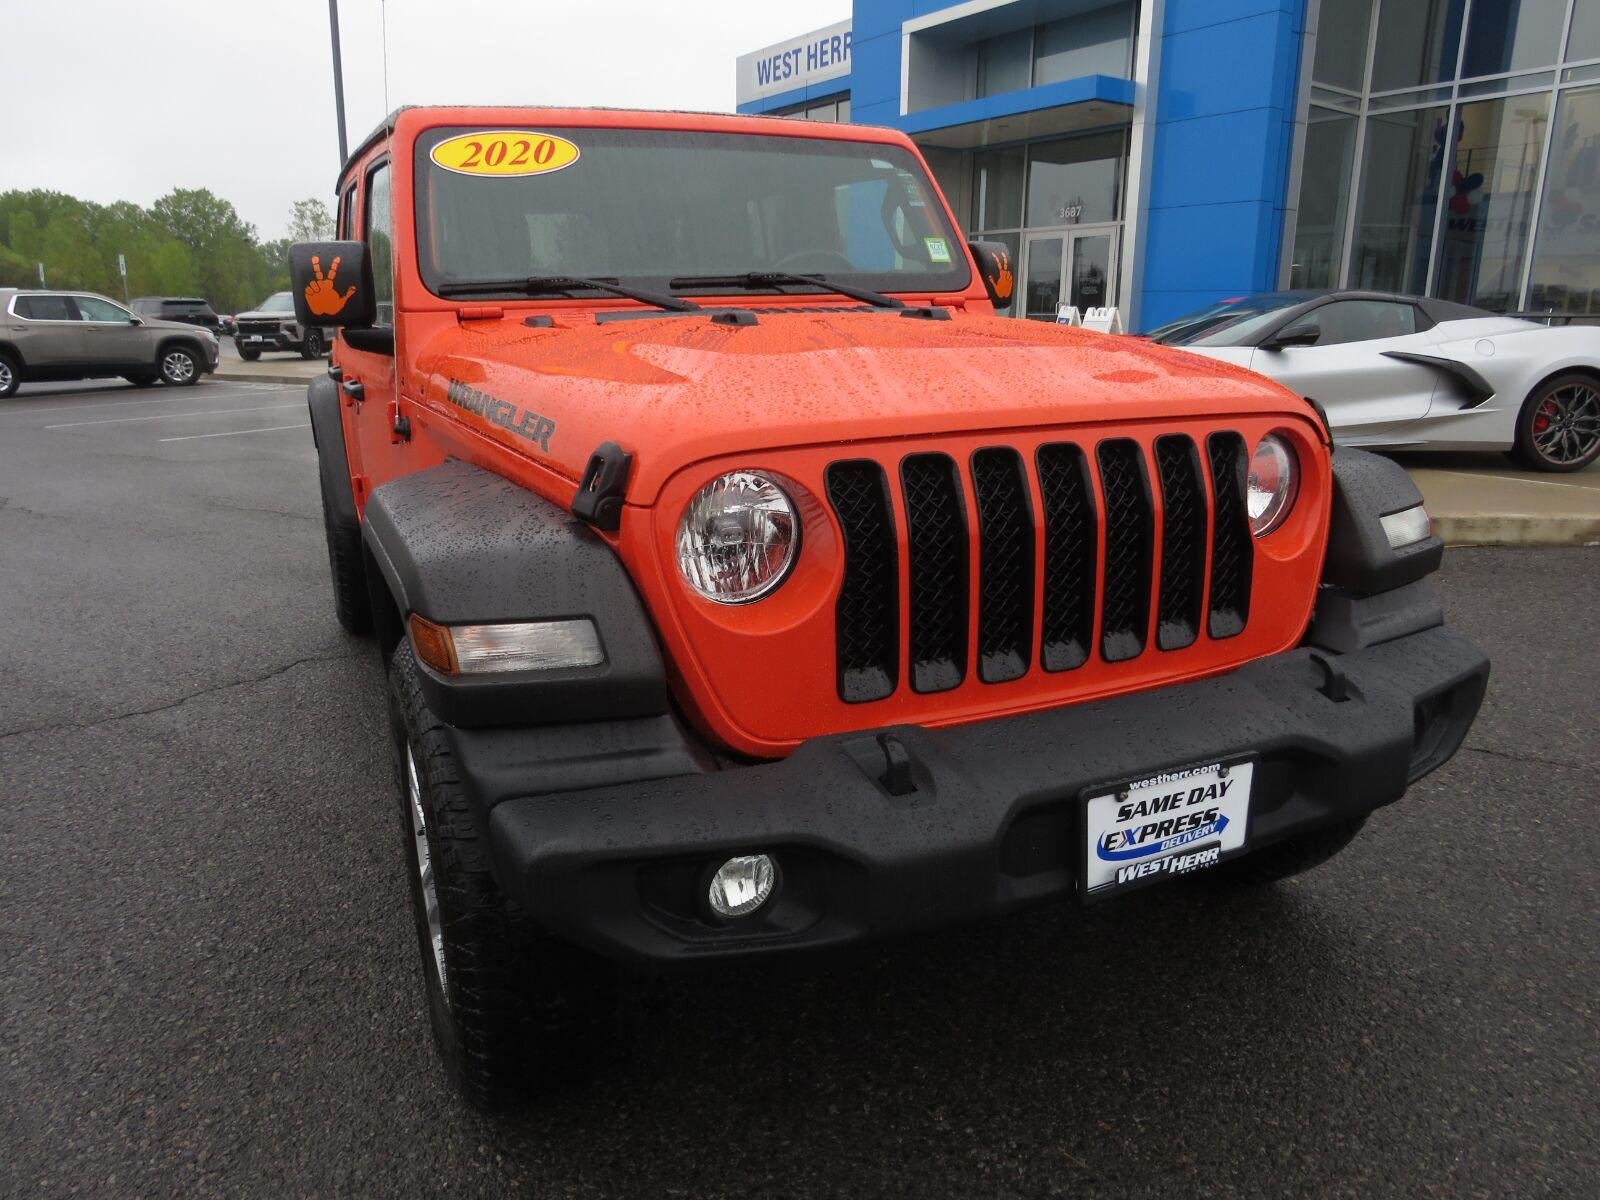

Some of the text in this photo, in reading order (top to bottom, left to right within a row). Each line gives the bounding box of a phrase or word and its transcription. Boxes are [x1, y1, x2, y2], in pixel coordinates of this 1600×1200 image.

[757, 31, 852, 86] WEST HERR
[459, 139, 556, 168] 2020
[1059, 206, 1082, 218] 3687
[447, 377, 556, 453] WRANGLER
[1129, 763, 1221, 790] westherr.com
[1116, 779, 1234, 823] SAME DAY
[1103, 807, 1220, 851] EXPRESS
[1160, 821, 1218, 851] DELIVERY
